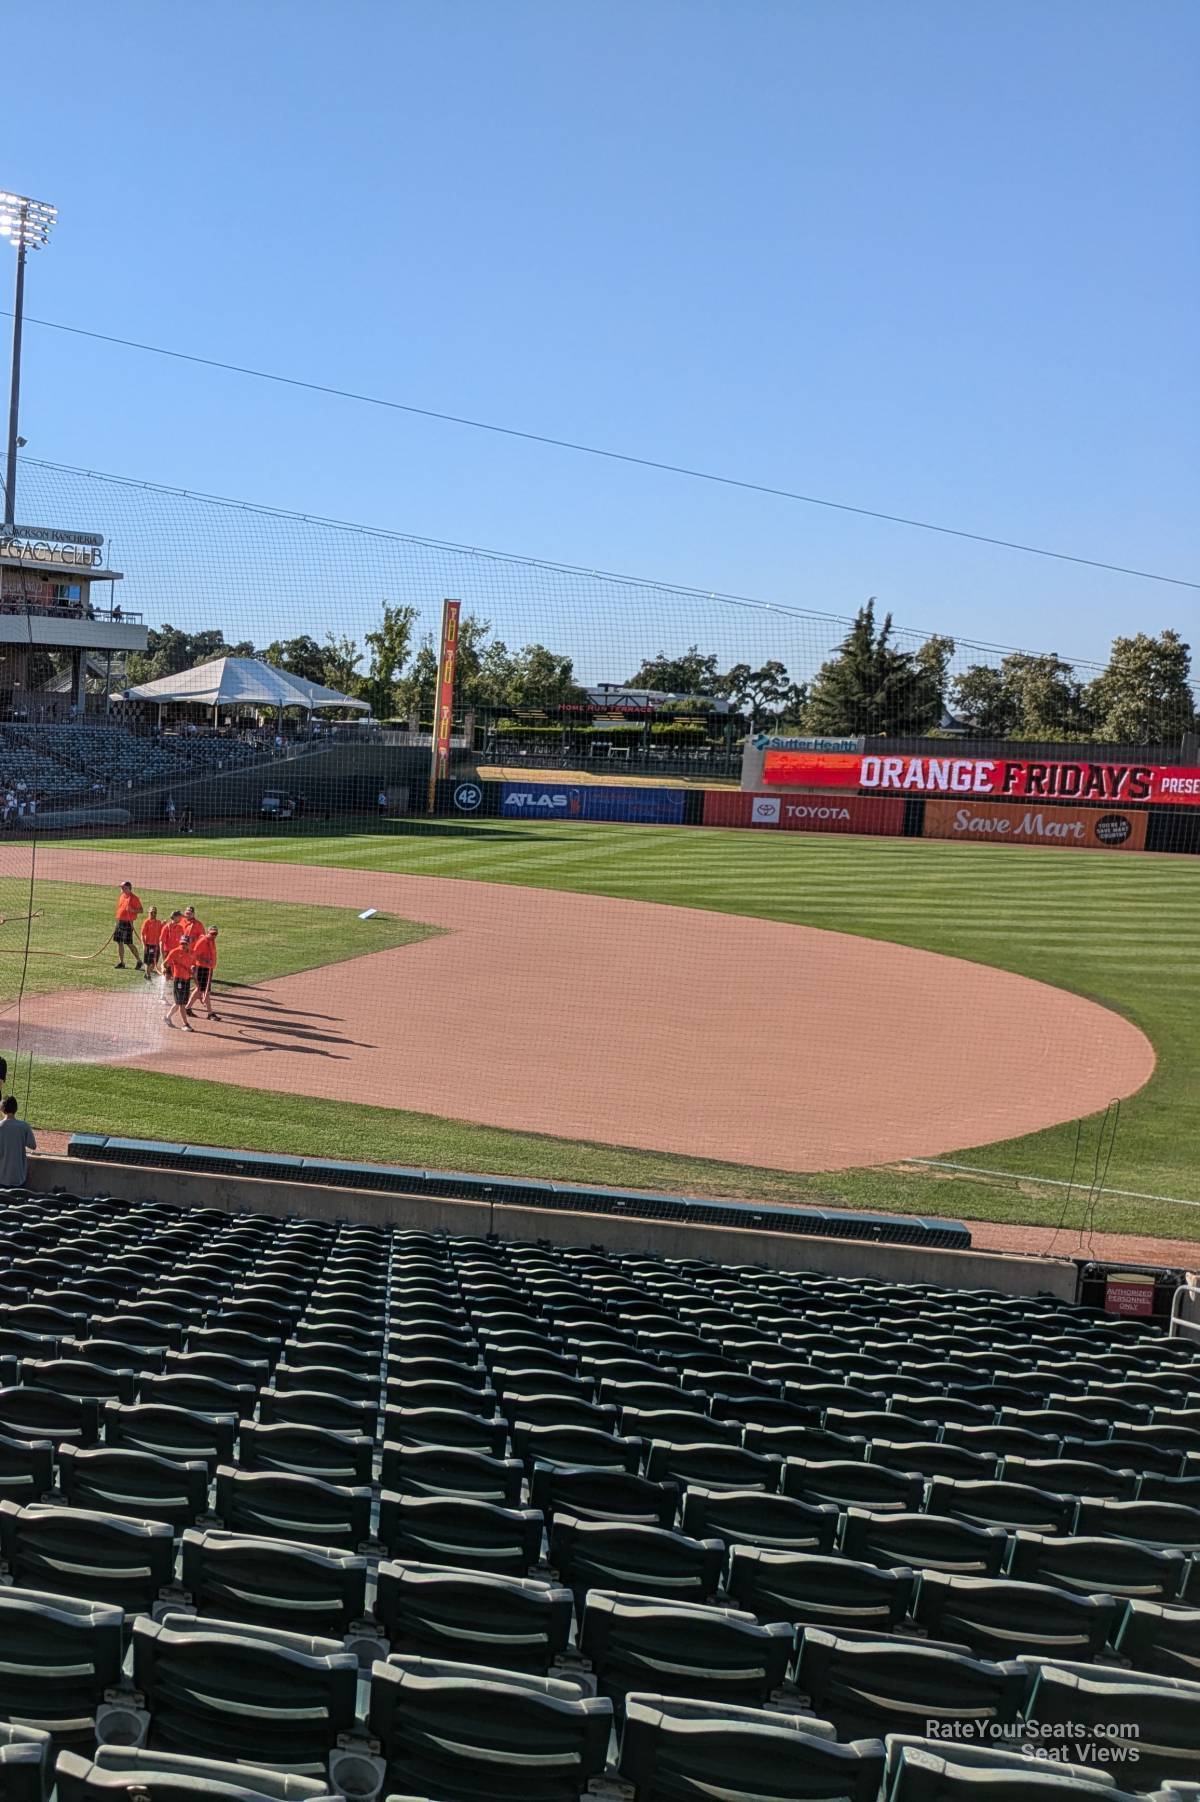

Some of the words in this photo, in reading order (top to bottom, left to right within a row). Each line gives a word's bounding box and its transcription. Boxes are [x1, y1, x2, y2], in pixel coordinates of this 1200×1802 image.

[60, 544, 103, 567] CLUB
[587, 704, 607, 712] RUN
[772, 738, 813, 749] Sutter
[814, 740, 857, 751] Health
[859, 756, 995, 793] ORANGE
[1002, 763, 1154, 801] FRIDAYS
[458, 790, 476, 804] 42
[504, 792, 568, 808] ATLAS
[785, 805, 850, 820] TOYOTA
[953, 809, 1010, 833] Save
[1013, 813, 1085, 839] Mart
[1106, 1288, 1153, 1298] AUTHORIZED
[1108, 1295, 1151, 1304] PERSONNEL
[1119, 1303, 1138, 1311] ONLY
